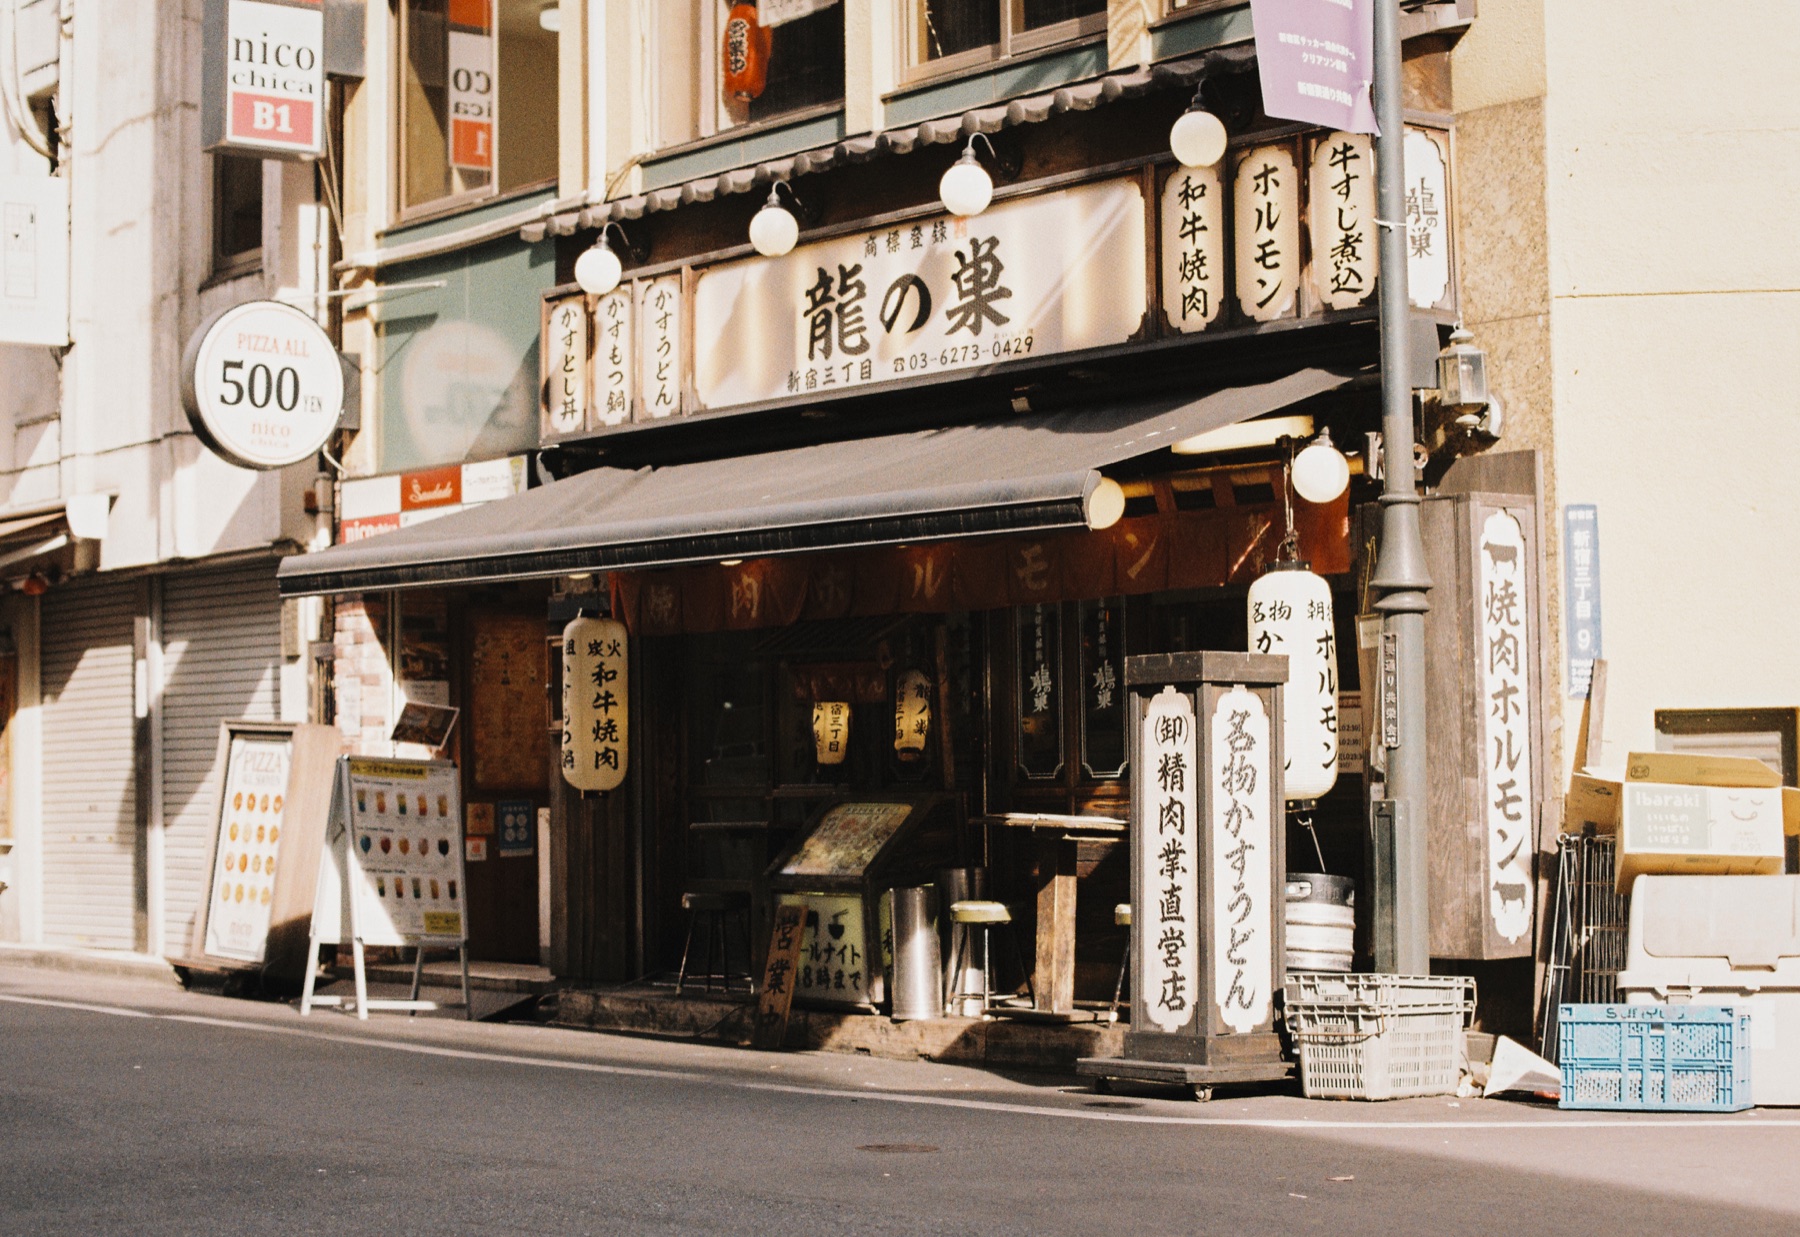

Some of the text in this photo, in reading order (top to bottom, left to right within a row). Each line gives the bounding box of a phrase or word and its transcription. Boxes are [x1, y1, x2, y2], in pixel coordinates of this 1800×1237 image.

[234, 32, 315, 71] nico
[232, 70, 313, 94] chica
[253, 100, 294, 133] B1
[864, 221, 948, 258] 商標登録
[1253, 163, 1282, 309] ホルモン
[1328, 142, 1364, 295] 牛すじ煮込
[1178, 175, 1209, 320] 和牛焼肉
[803, 235, 1013, 362] 龍の巣
[237, 333, 310, 358] PIZZA ALL
[560, 307, 578, 420] かすとじ丼
[606, 297, 626, 414] かすもつ鍋
[655, 289, 674, 407] かすうどん
[220, 359, 323, 413] 500 YEN
[787, 358, 872, 393] 新宿三丁目
[1251, 600, 1292, 624] 名物
[587, 639, 621, 658] 炭火
[1577, 629, 1591, 650] 9
[592, 661, 619, 771] 和牛焼肉
[1316, 629, 1338, 770] ホルモン
[1485, 579, 1525, 872] 焼肉ホルモン
[243, 751, 281, 773] PIZZA
[1636, 791, 1700, 807] Ibaraki
[1222, 708, 1258, 1011] 名物かすうどん
